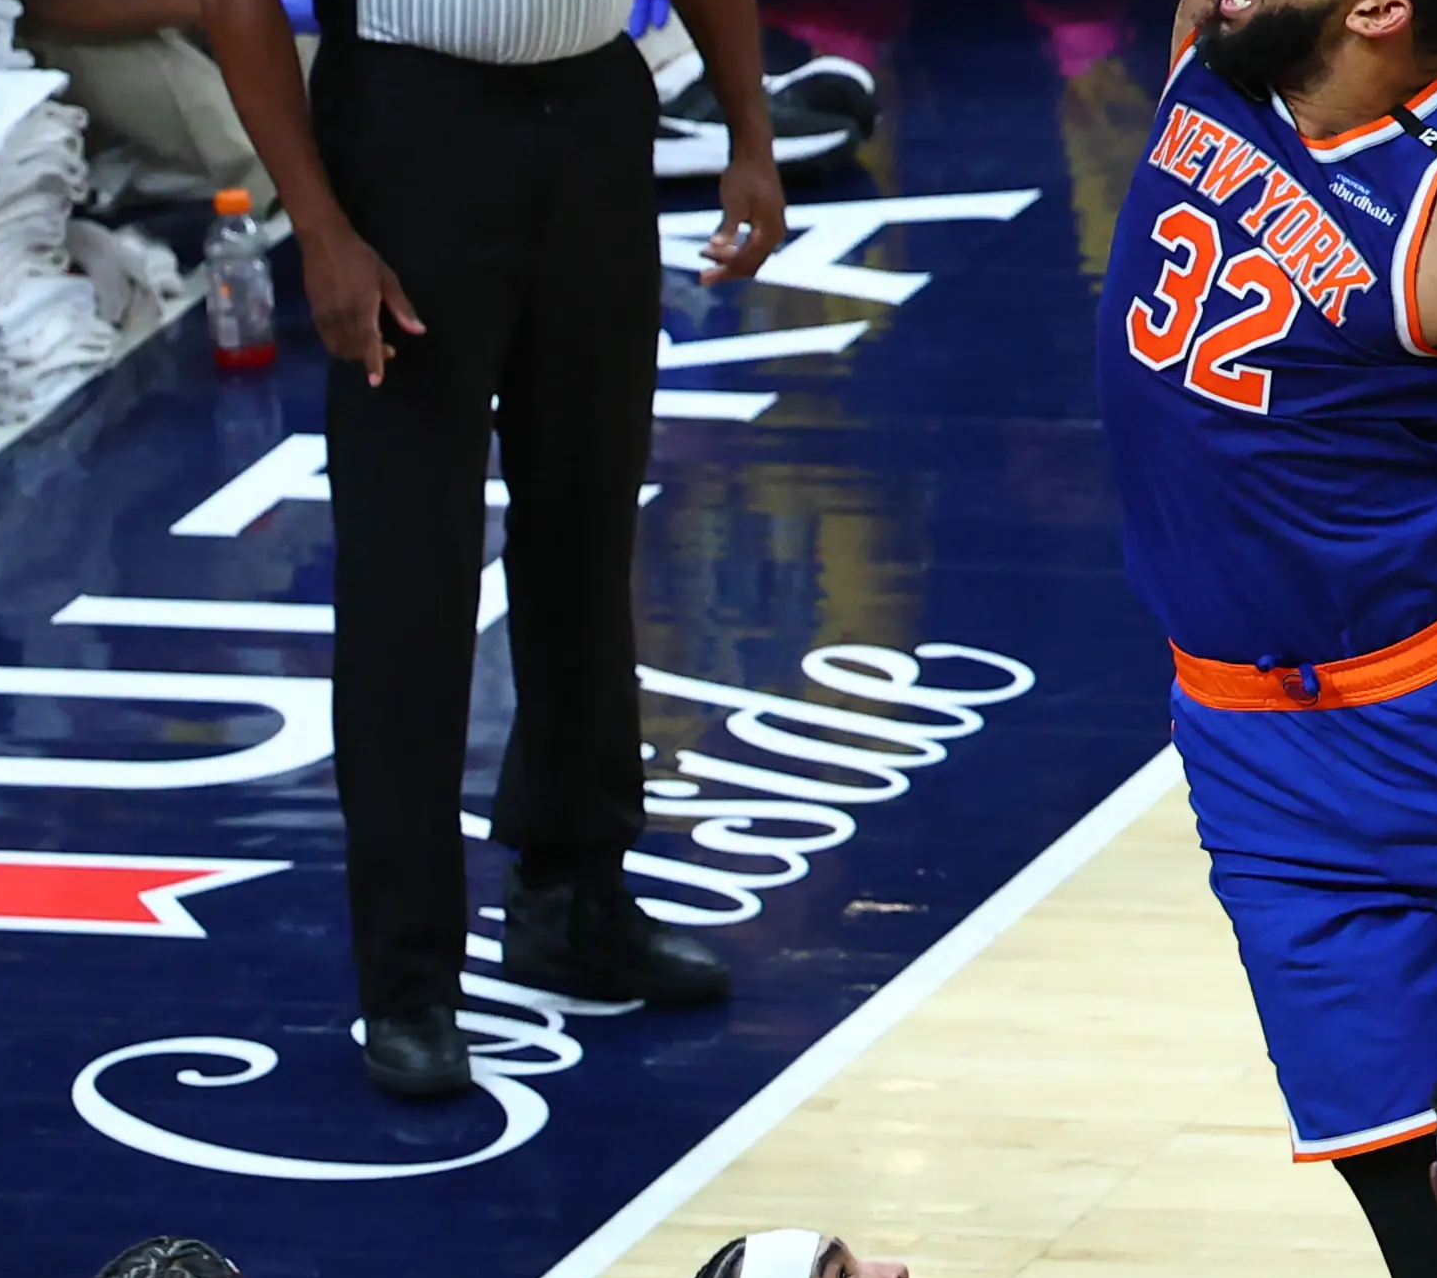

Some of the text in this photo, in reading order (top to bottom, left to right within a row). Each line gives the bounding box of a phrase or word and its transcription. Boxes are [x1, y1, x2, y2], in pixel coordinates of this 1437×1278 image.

[1125, 201, 1302, 416] 32
[1148, 101, 1379, 328] NEW YORK
[1328, 181, 1398, 227] abu dhabi
